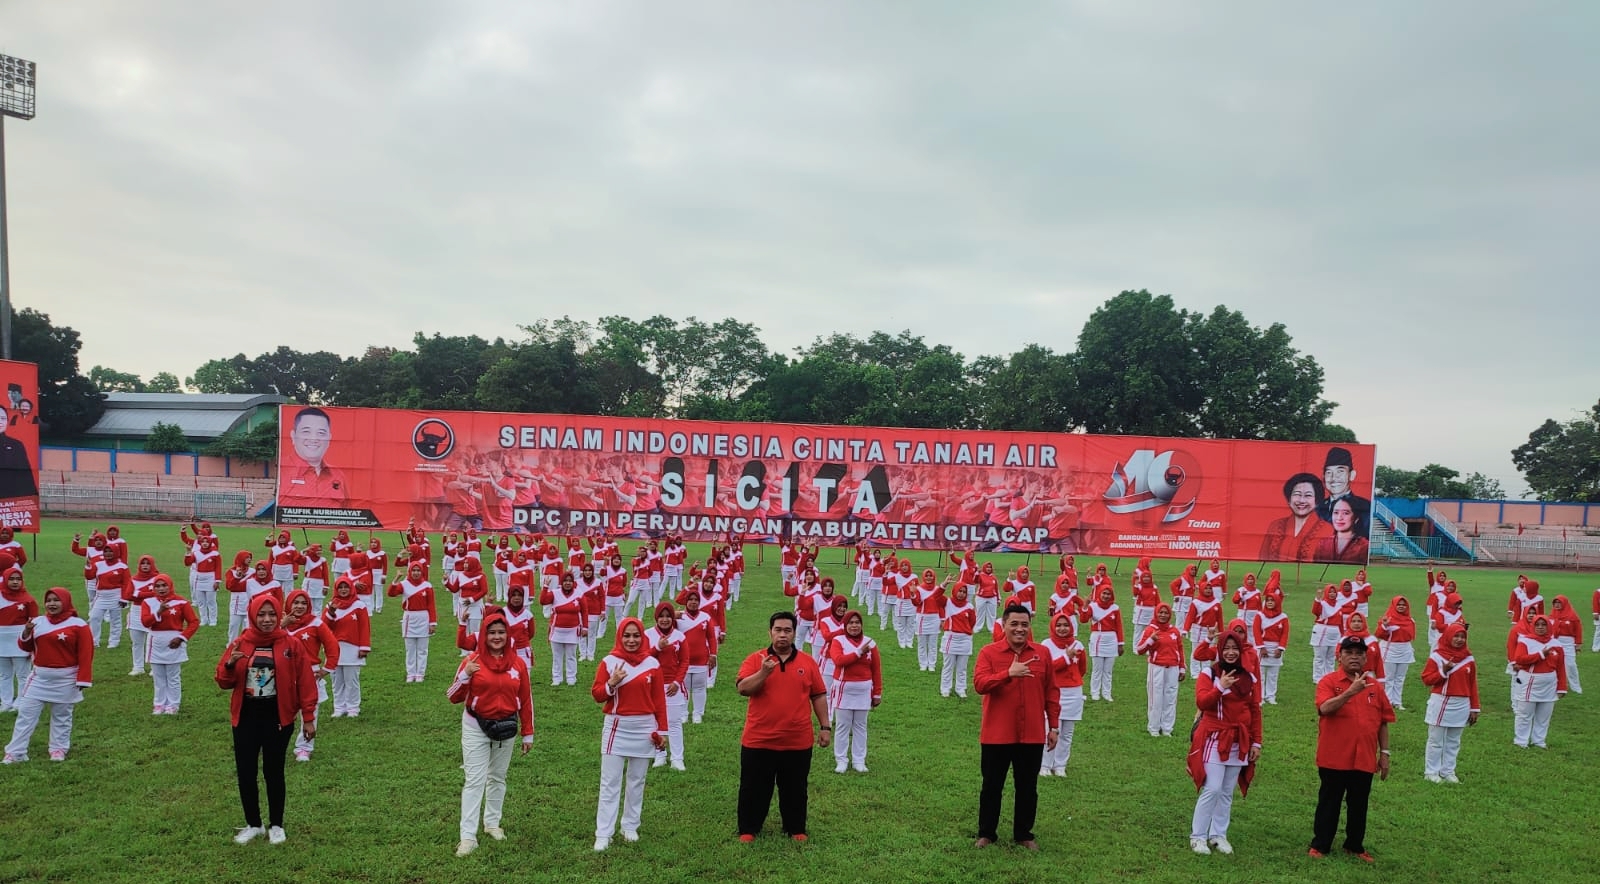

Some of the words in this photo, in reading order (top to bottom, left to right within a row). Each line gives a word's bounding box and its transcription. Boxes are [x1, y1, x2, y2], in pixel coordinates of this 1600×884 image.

[499, 425, 604, 450] SENAM
[613, 429, 784, 459] INDONESIA
[793, 437, 886, 463] CINTA
[895, 440, 995, 466] TANAH
[1004, 444, 1058, 468] AIR
[660, 471, 879, 515] SICITA
[282, 507, 312, 515] TAUFIK
[313, 508, 362, 517] NURHIDAYAT
[3, 519, 32, 527] RAYA
[513, 508, 562, 526] DPC
[569, 511, 610, 529] PDI
[616, 512, 783, 535] PERJUANGAN
[791, 520, 937, 541] KABUPATEN
[943, 525, 1050, 544] CILACAP
[1188, 519, 1221, 529] Tahun
[1168, 541, 1221, 550] INDONESIA
[1196, 549, 1219, 557] RAYA
